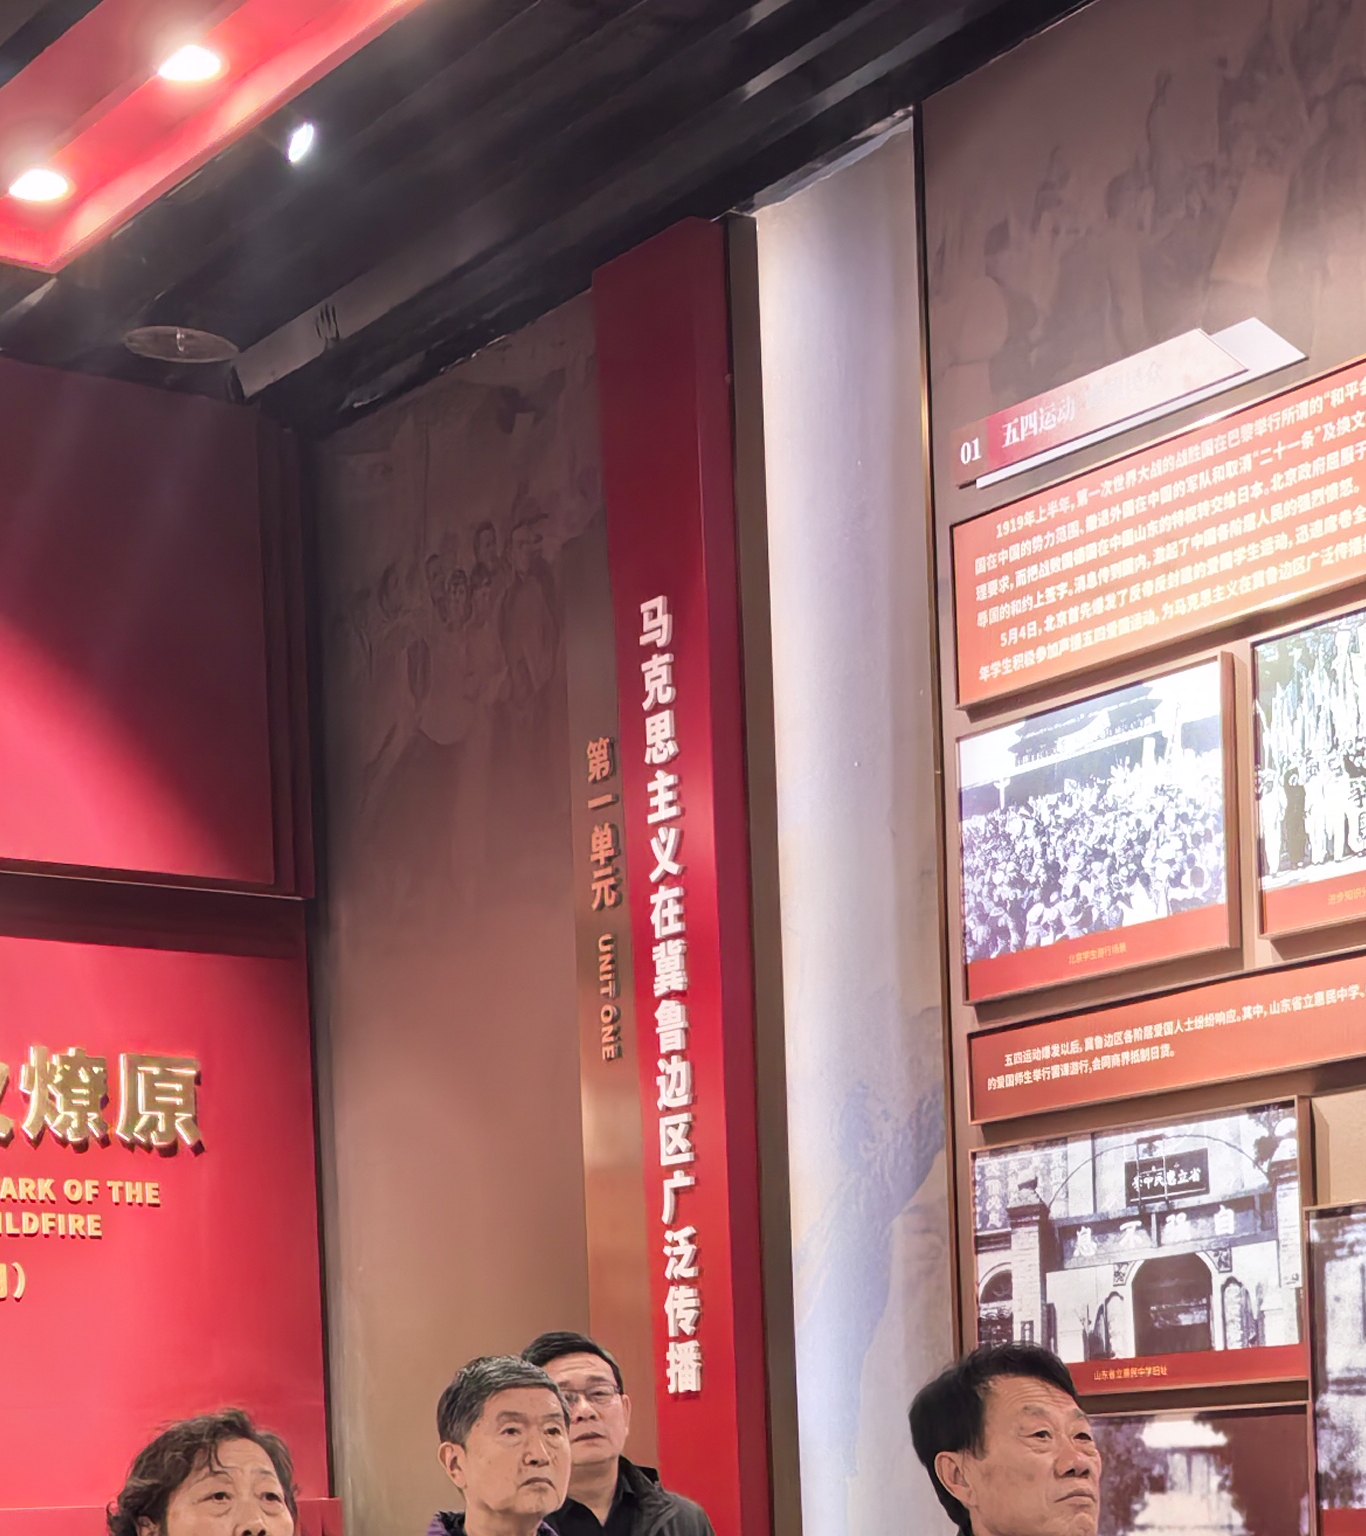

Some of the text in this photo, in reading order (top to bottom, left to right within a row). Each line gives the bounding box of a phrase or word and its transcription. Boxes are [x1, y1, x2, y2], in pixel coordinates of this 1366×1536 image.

[960, 437, 981, 465] 01
[1002, 395, 1076, 448] 五四运动
[586, 736, 622, 912] 第一单元
[598, 933, 617, 1061] UNIT ONE
[639, 594, 704, 1397] 马克思主义在冀鲁边区广泛传播
[63, 1178, 100, 1204] OF
[107, 1179, 162, 1207] THE
